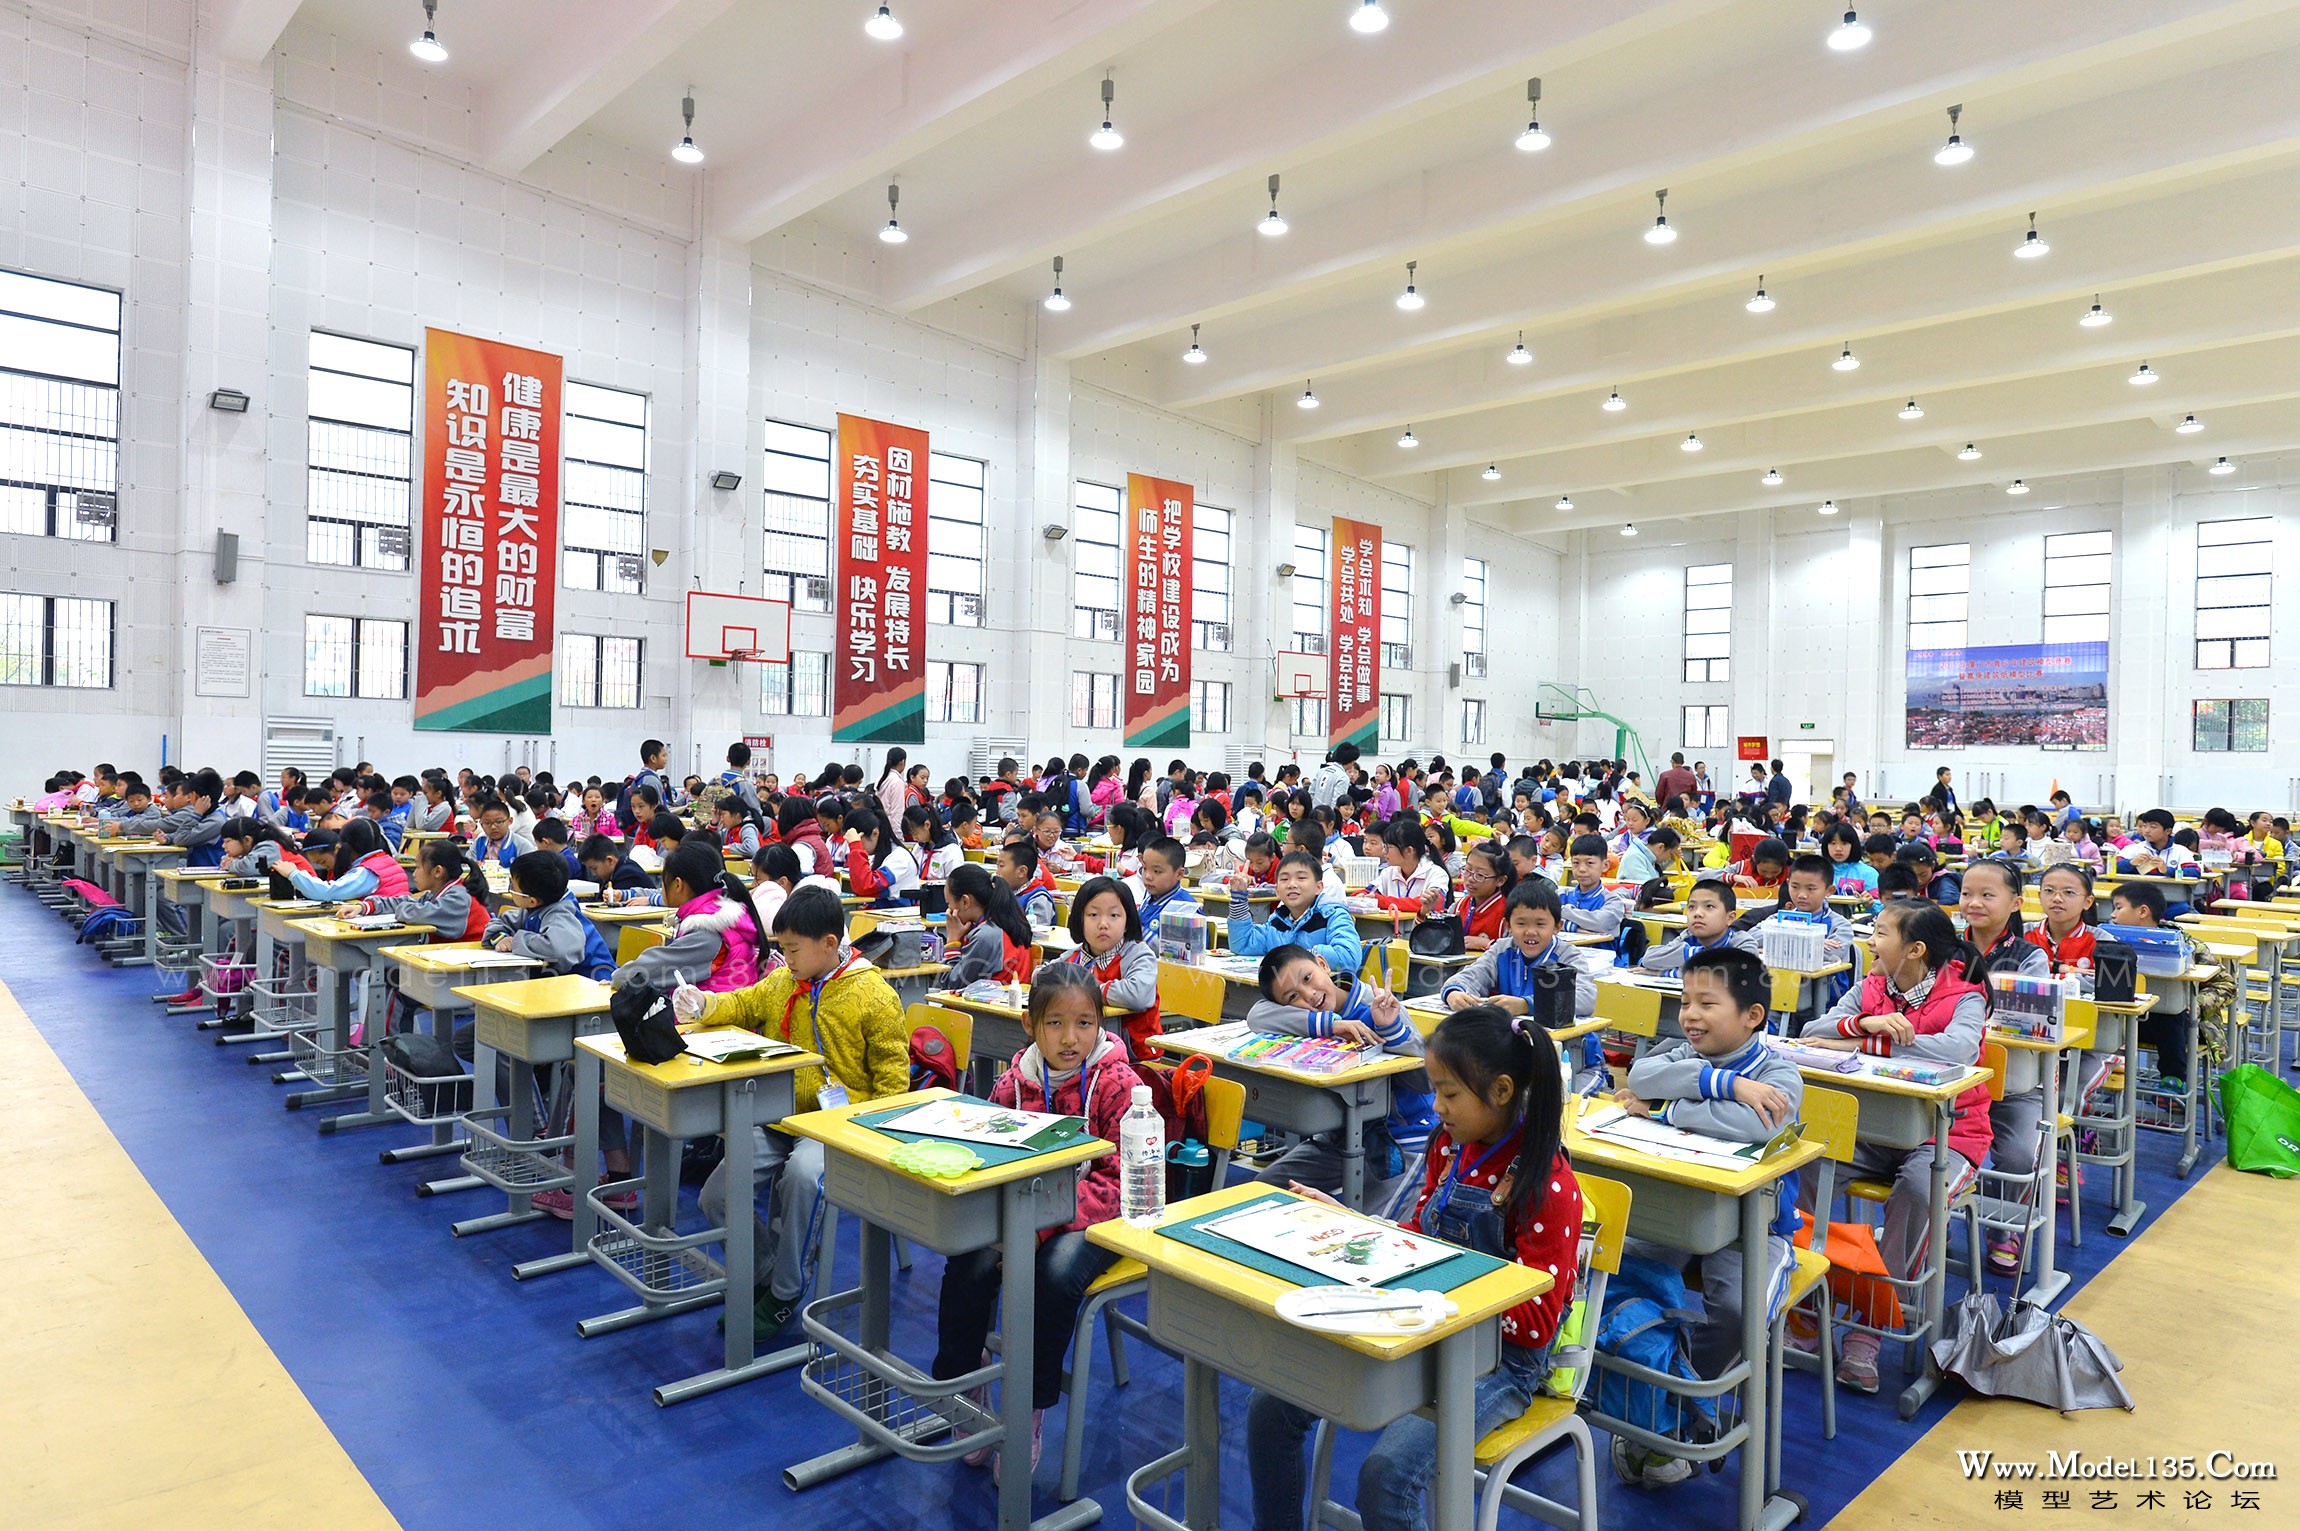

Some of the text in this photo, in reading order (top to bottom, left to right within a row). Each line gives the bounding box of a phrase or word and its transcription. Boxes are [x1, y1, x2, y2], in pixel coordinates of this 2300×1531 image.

[438, 377, 489, 654] 知识是永恒的追求
[495, 371, 543, 641] 健康是最大的财富
[850, 453, 880, 683] 夯实基础 快乐学习
[884, 445, 912, 671] 因材施教 发展特长
[1136, 507, 1158, 695] 师生的精神家园
[1160, 498, 1182, 683] 把学校建设成为
[1338, 545, 1355, 712] 学会共处 学会生存
[1356, 538, 1374, 703] 学会求知 学会做事
